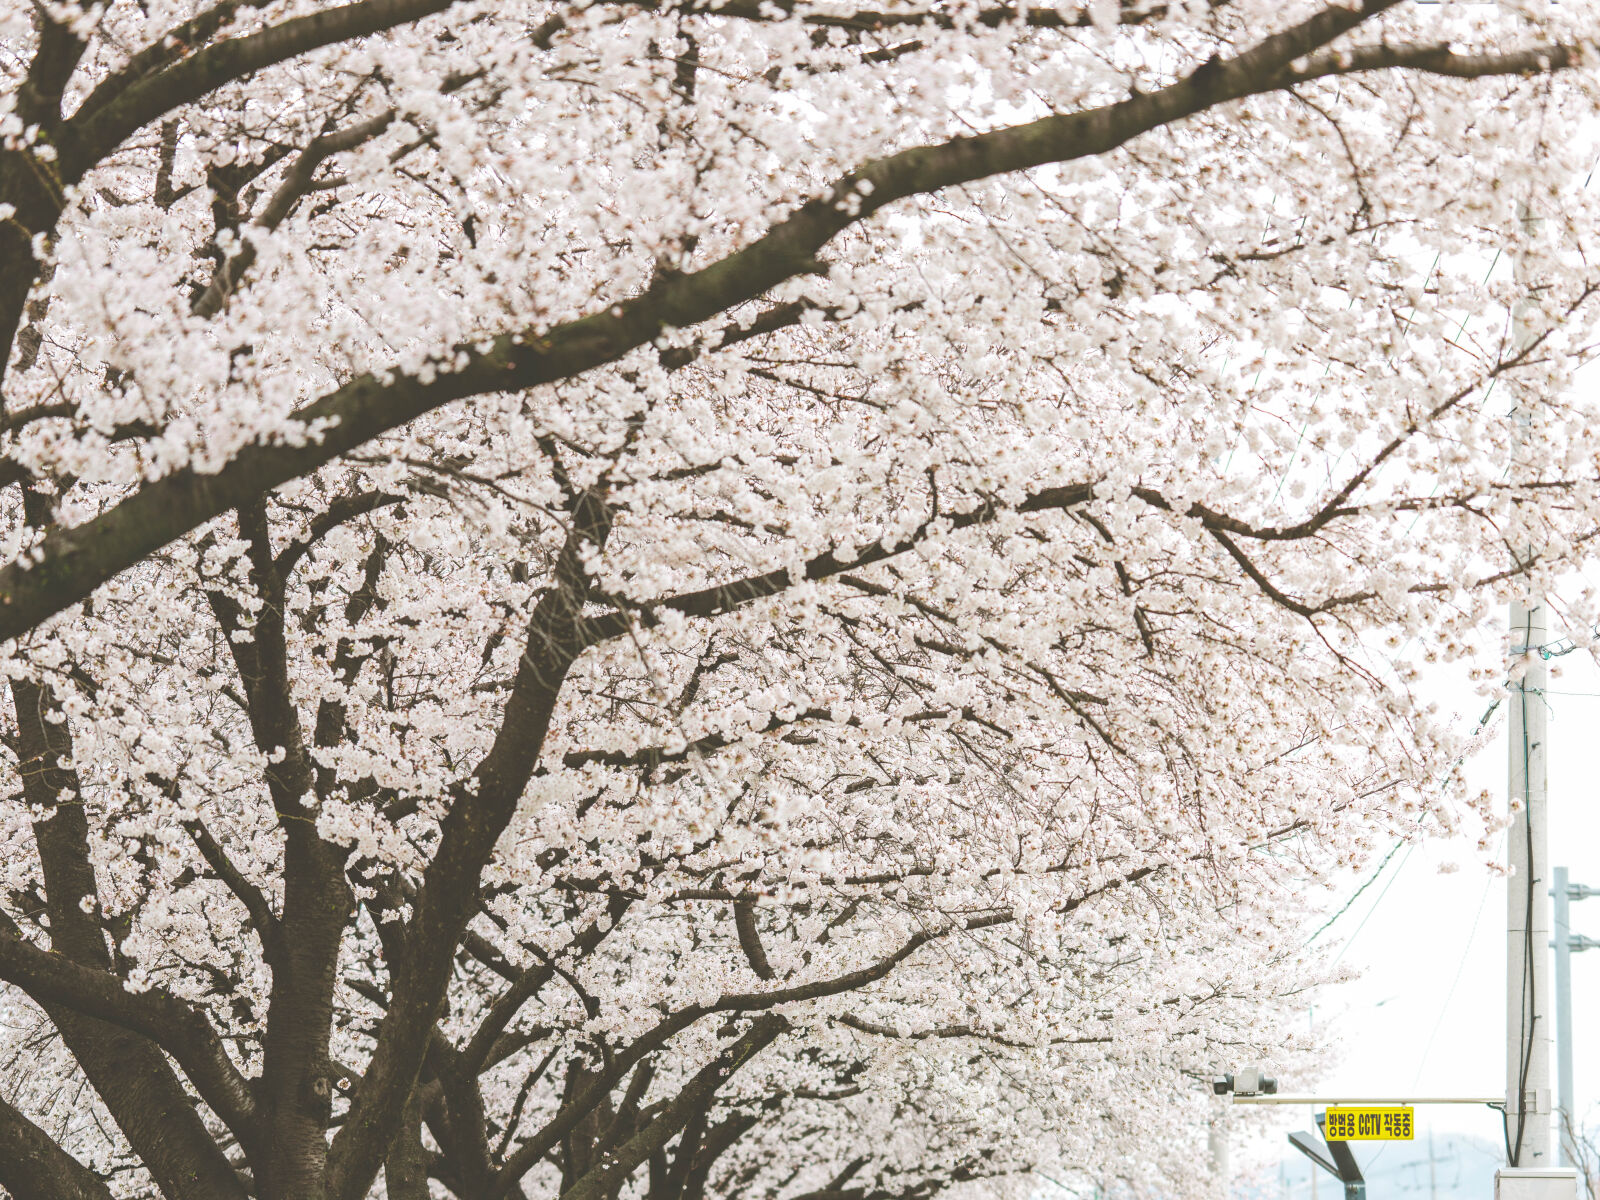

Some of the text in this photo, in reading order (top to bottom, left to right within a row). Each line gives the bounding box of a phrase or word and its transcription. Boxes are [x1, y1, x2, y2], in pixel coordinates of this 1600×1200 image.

[1329, 1113, 1410, 1137] 방범용 CCTV 작동중
